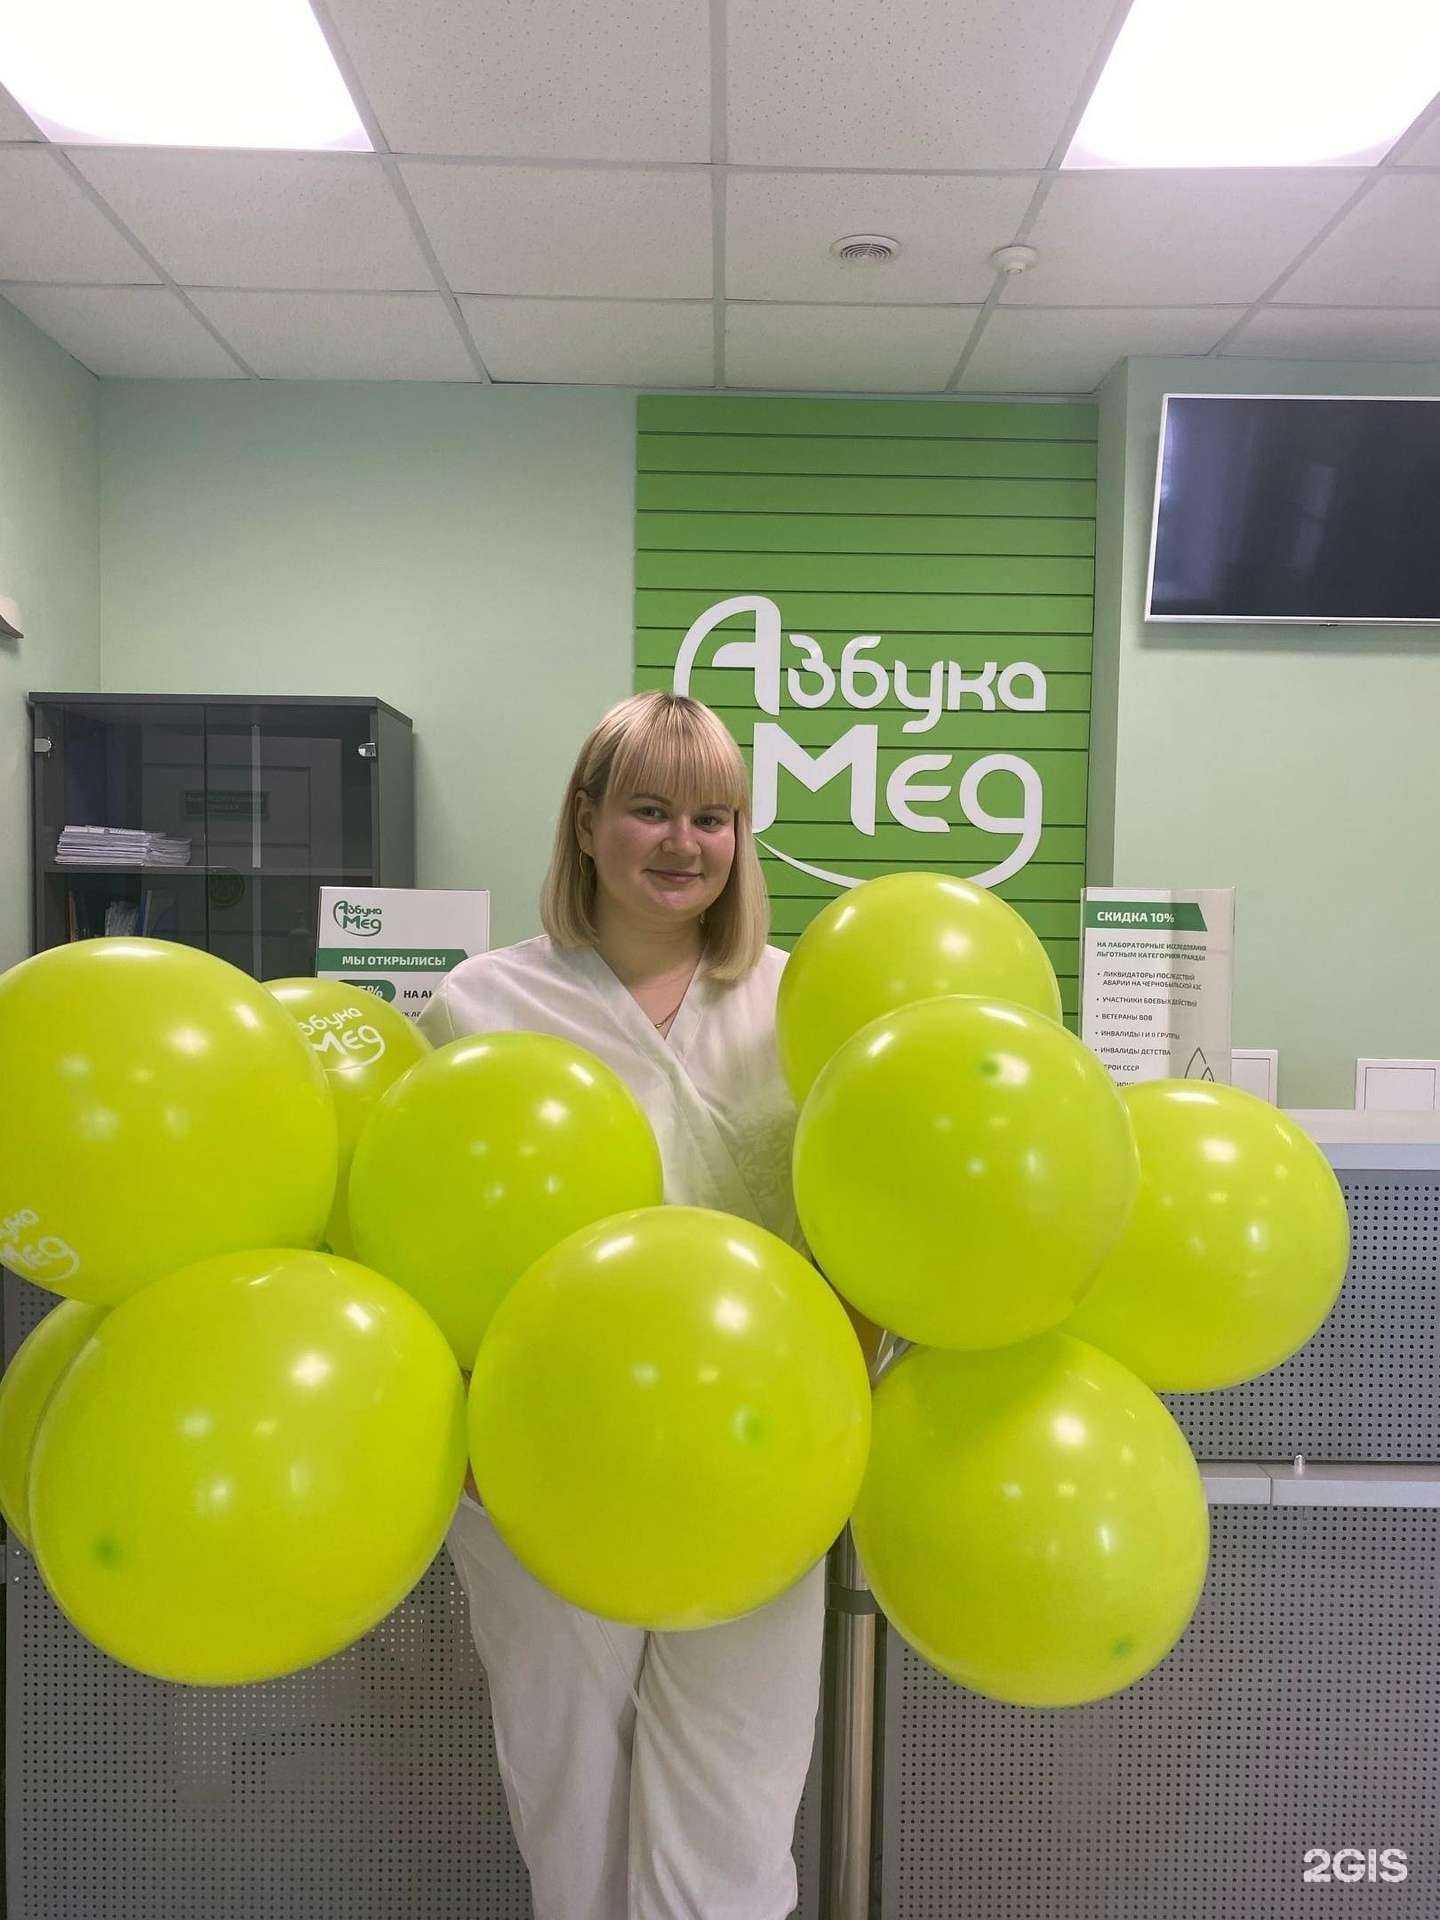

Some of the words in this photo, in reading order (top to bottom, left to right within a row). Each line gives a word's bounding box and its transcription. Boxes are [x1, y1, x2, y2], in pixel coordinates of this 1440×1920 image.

[673, 595, 1047, 734] Азбука
[751, 722, 1044, 888] Мед
[333, 900, 382, 918] Азбука
[1096, 911, 1148, 923] СКИДКА
[1150, 912, 1175, 924] 10%
[341, 915, 382, 937] Мед
[1108, 942, 1165, 950] ЛАБОРАТОРНЫЕ
[342, 956, 365, 966] МЫ
[367, 956, 446, 967] ОТКРЫЛИСЬ!
[1103, 971, 1155, 979] ЛИКВИДАТОРЫ
[403, 990, 419, 999] НА
[1102, 996, 1142, 1004] УЧАСТНИКИ
[1101, 1013, 1138, 1021] ВЕТЕРАНЫ
[1101, 1030, 1140, 1038] ИНВАЛИДЫ
[1100, 1047, 1140, 1055] ИНВАЛИДЫ
[1141, 1048, 1171, 1056] ДЕТСТВА
